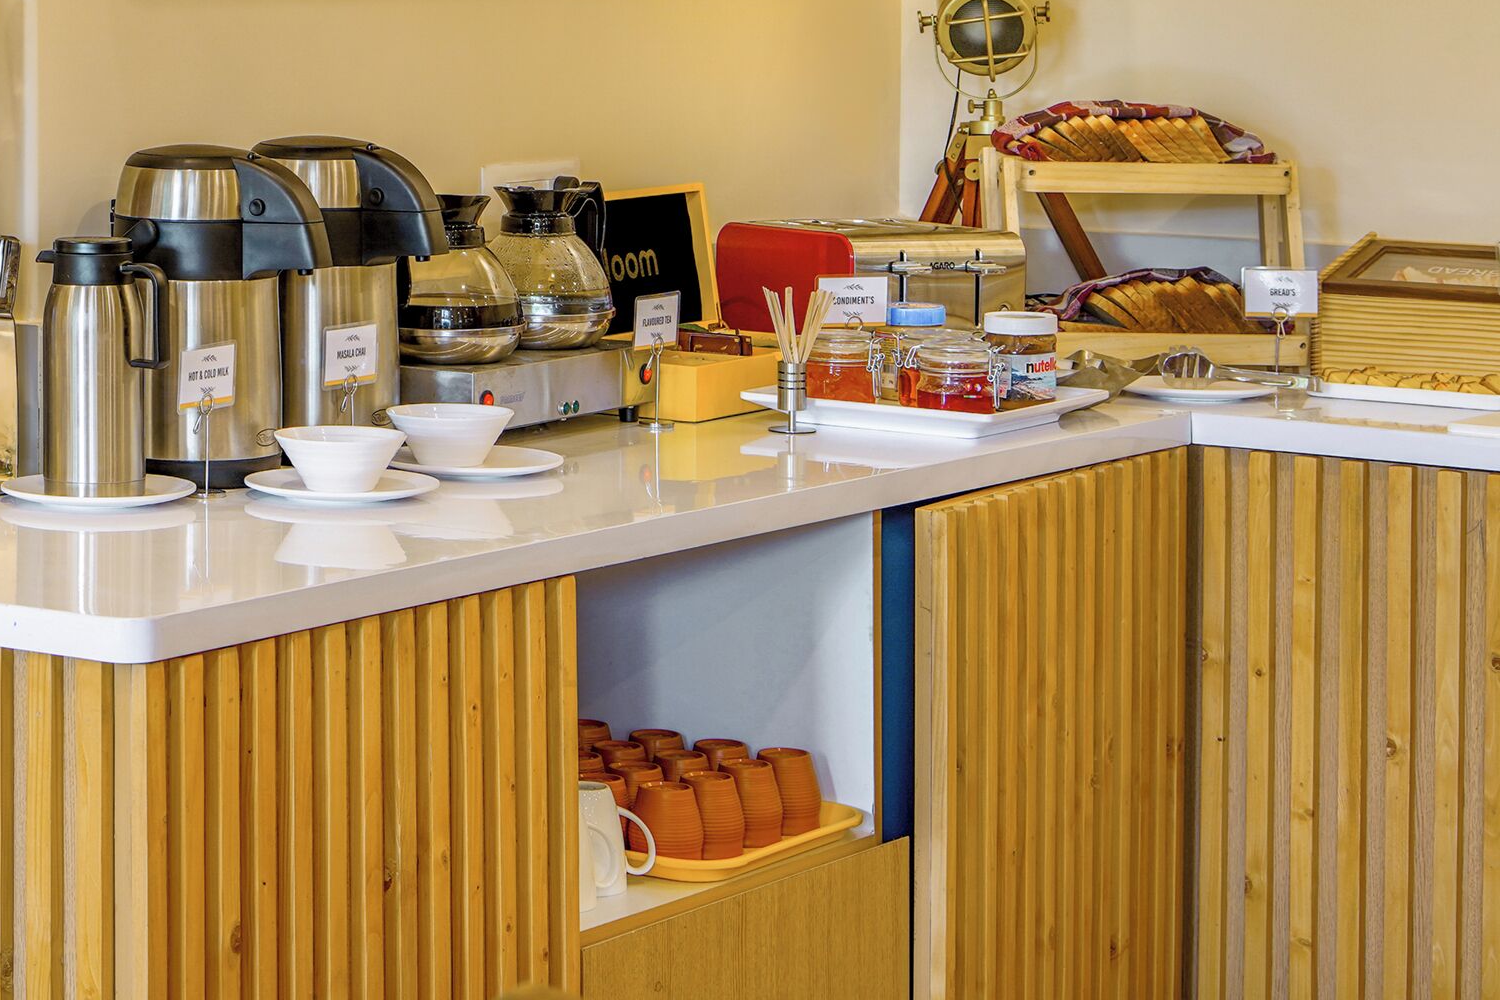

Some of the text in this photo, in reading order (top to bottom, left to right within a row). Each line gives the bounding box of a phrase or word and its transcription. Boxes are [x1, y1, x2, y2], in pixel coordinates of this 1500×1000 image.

[602, 248, 660, 283] loom
[930, 261, 955, 270] AGARO
[642, 316, 664, 327] FLAVOURED
[336, 347, 366, 359] MASALA CHAI
[188, 371, 198, 381] HOT
[204, 368, 216, 379] COLD
[217, 366, 229, 377] MILK
